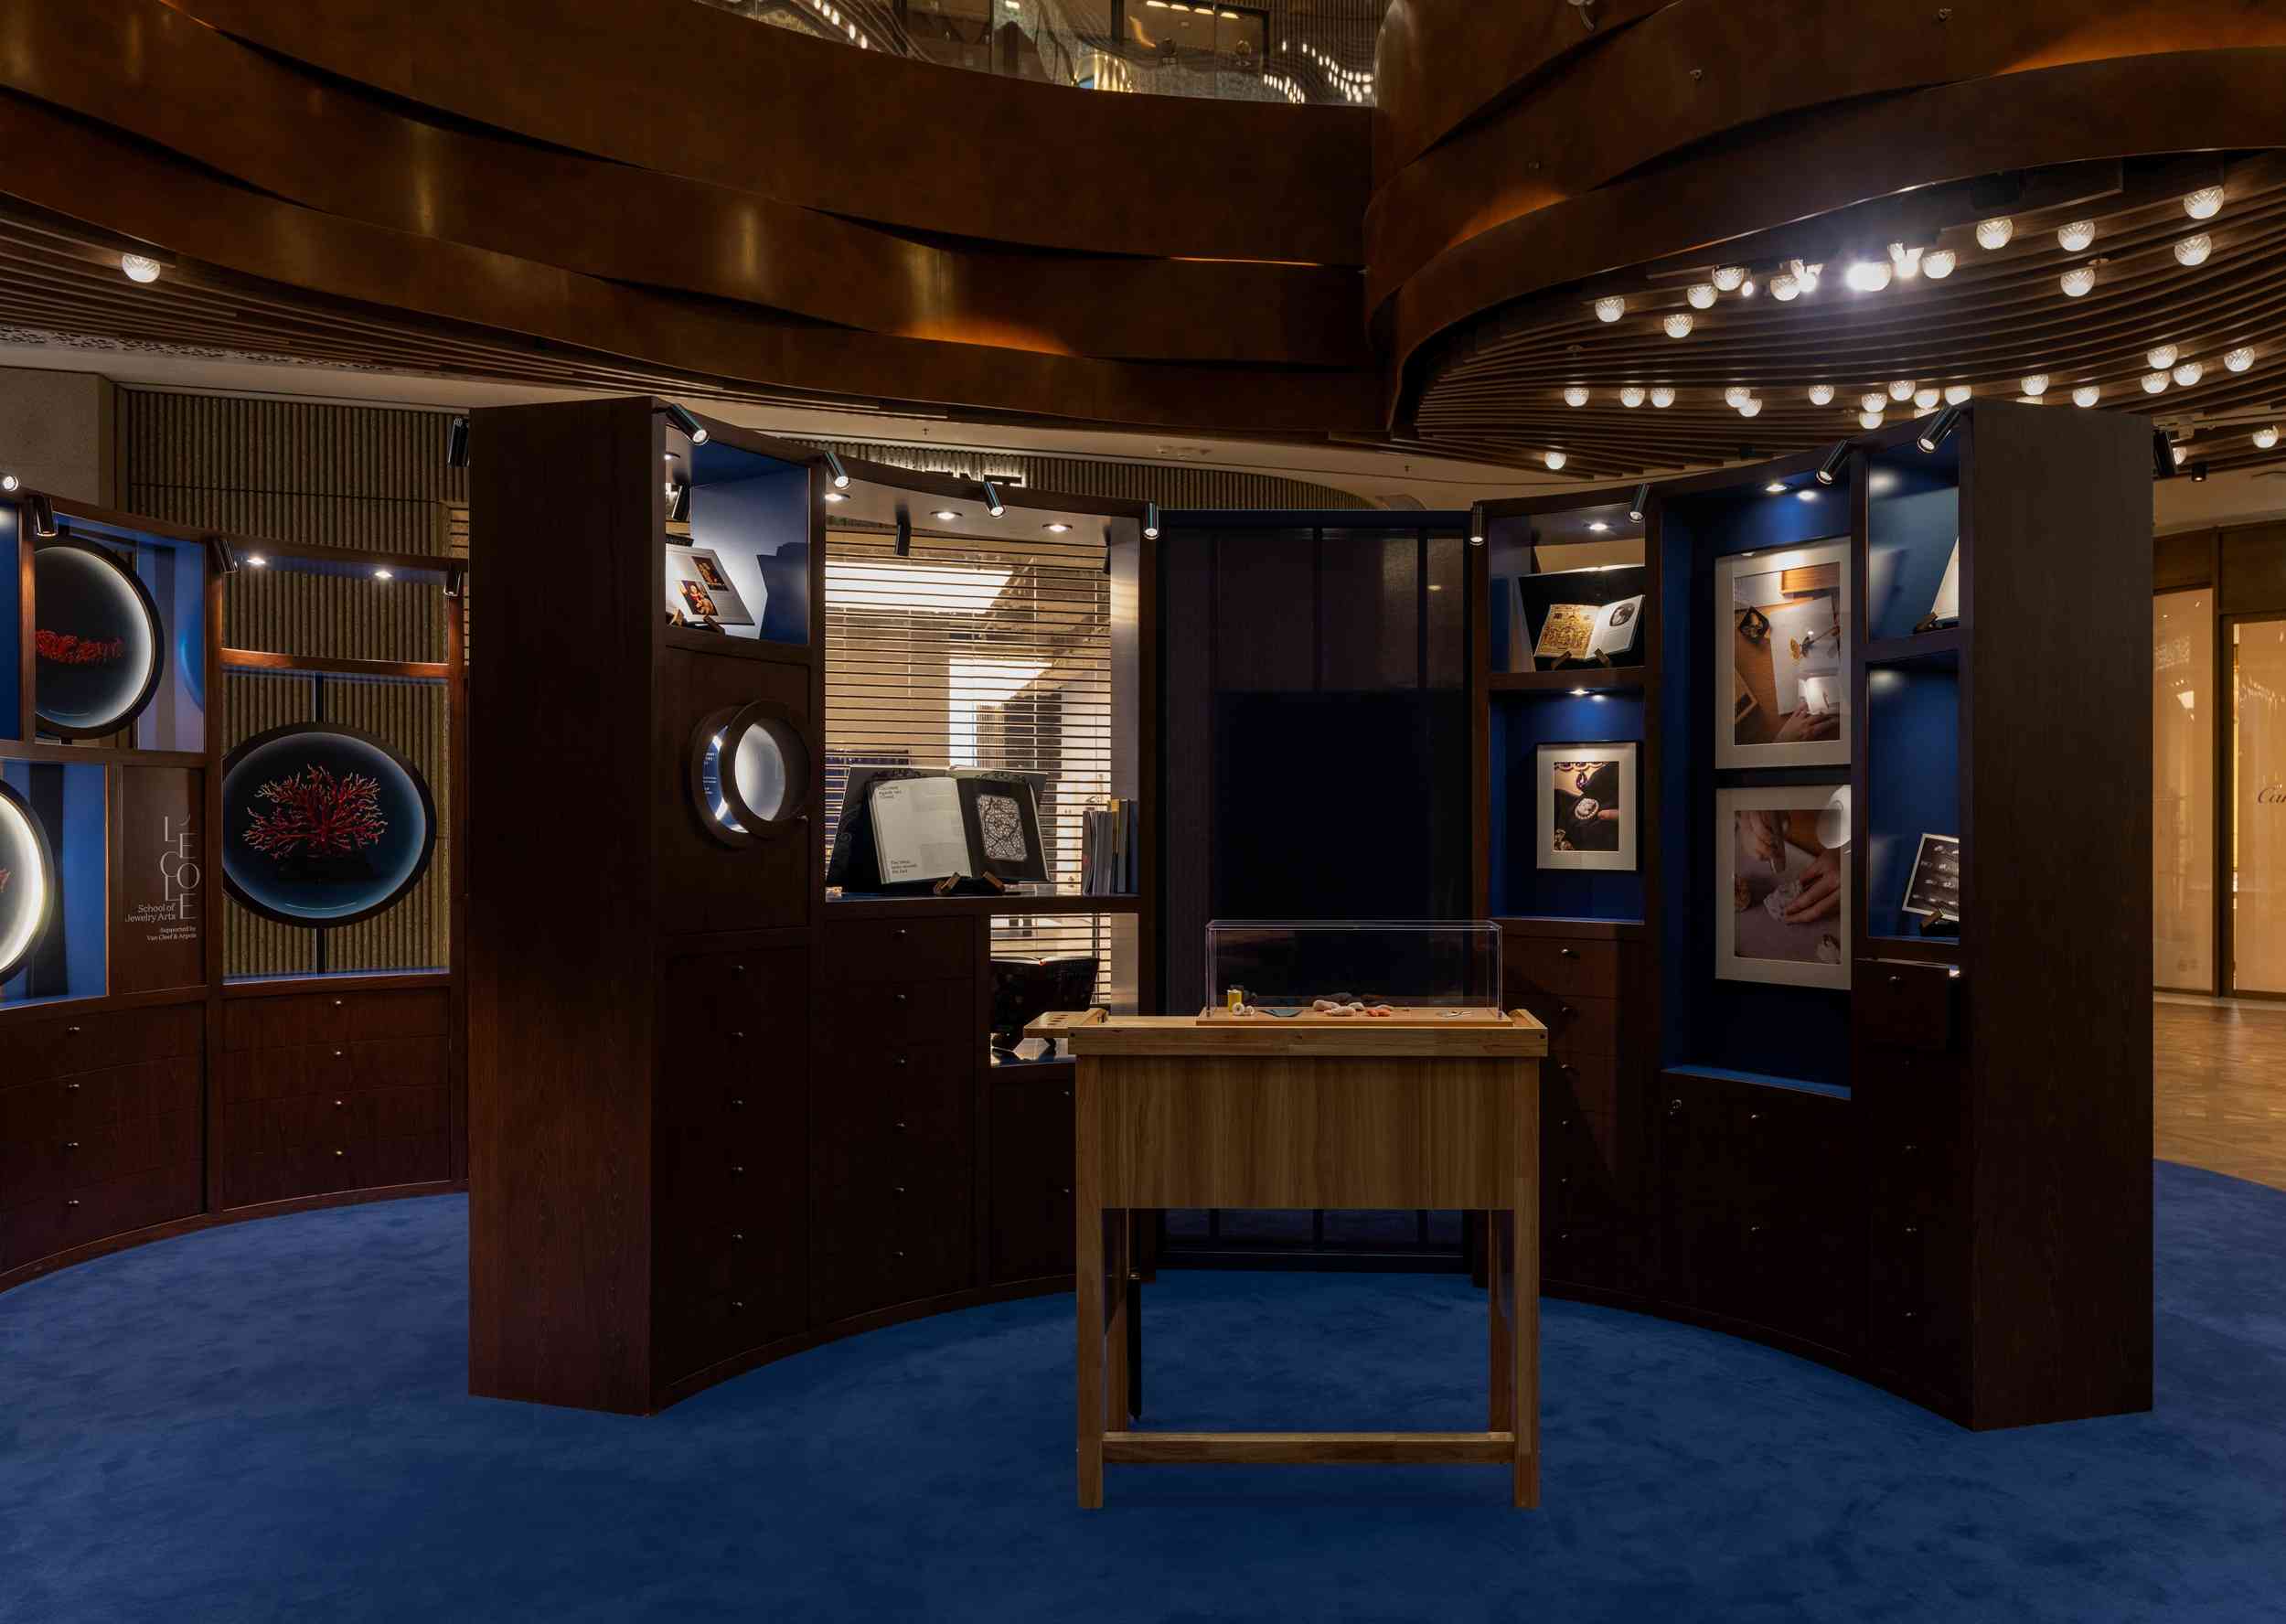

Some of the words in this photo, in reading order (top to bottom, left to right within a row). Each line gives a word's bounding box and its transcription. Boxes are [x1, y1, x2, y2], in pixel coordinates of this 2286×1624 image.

[138, 903, 166, 913] School
[167, 903, 176, 912] of
[125, 913, 156, 923] Jewelry
[157, 913, 176, 921] Arts
